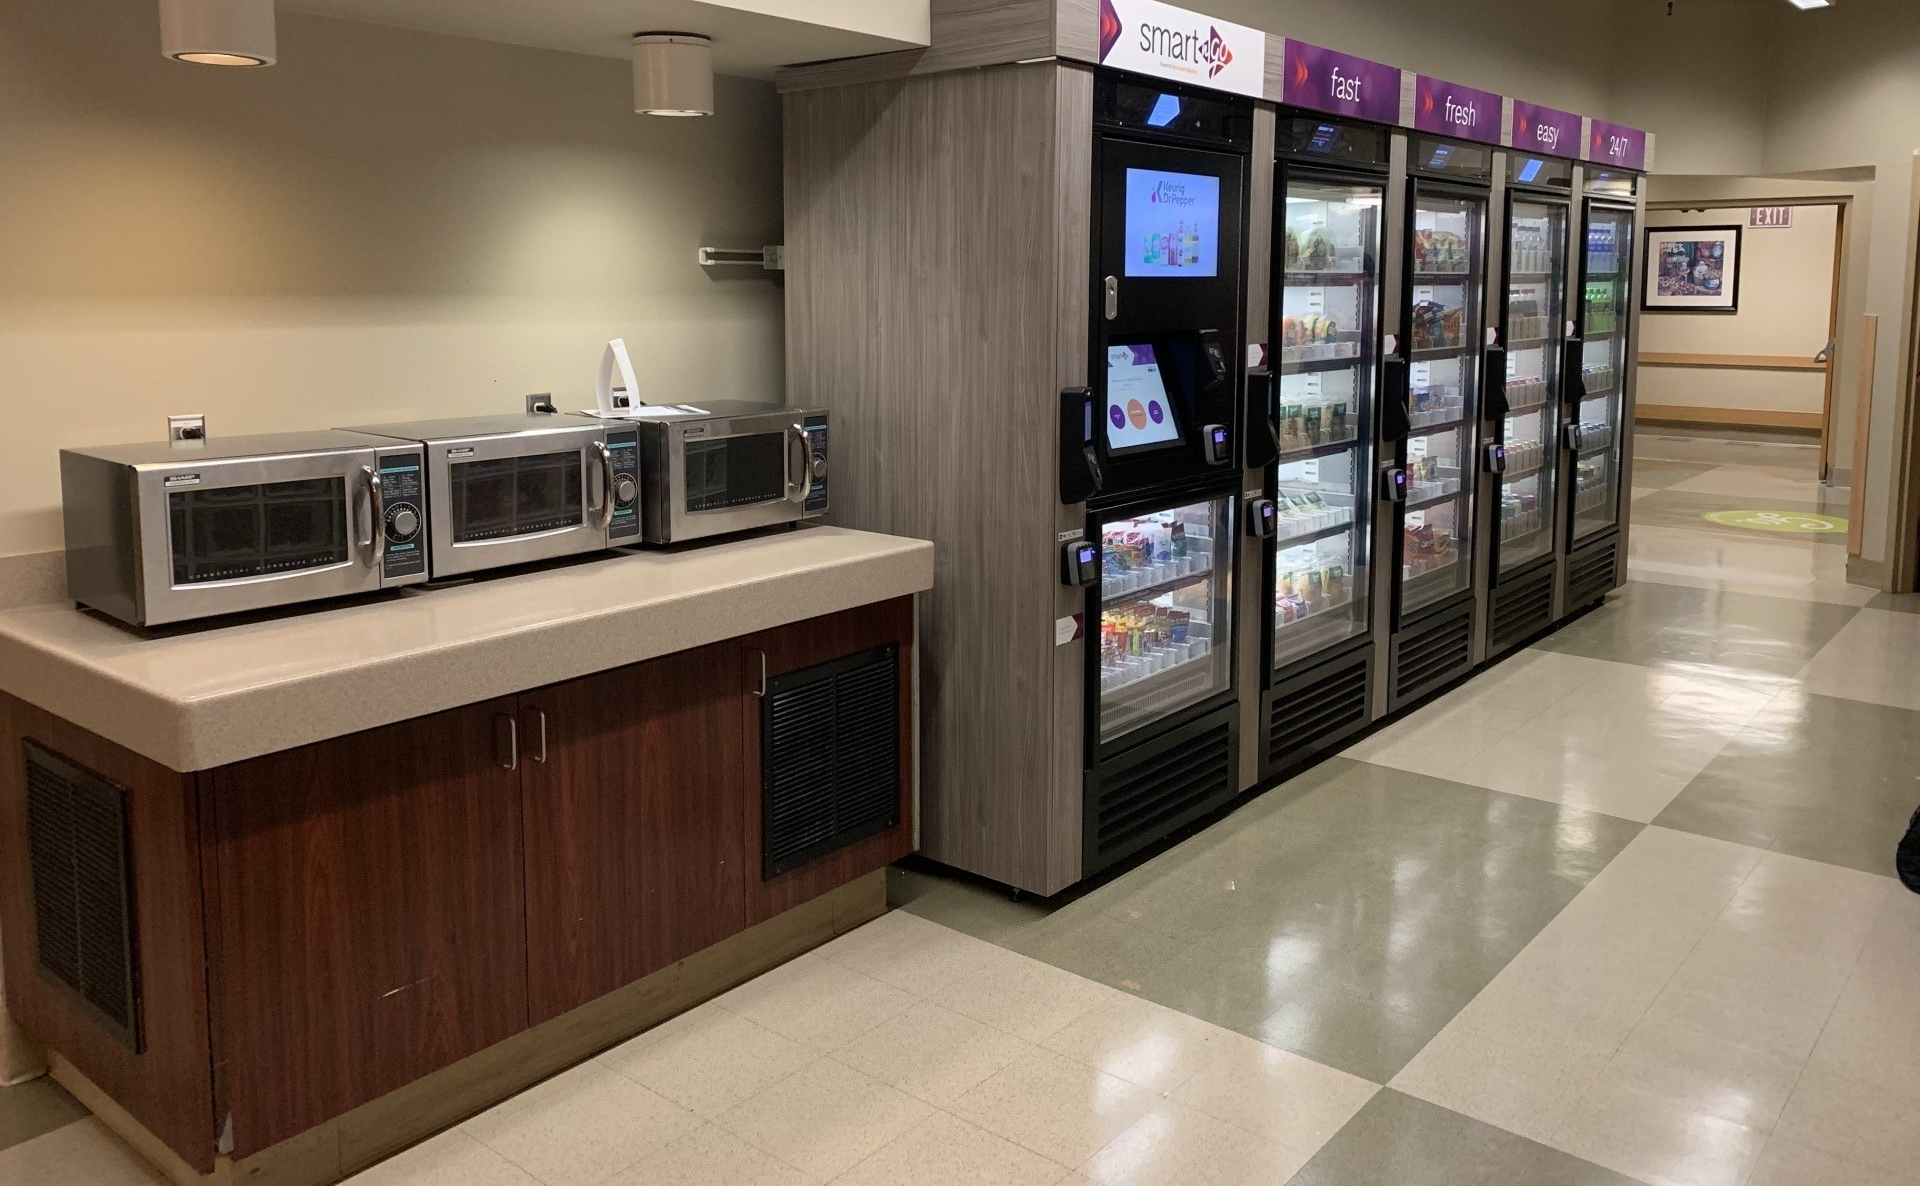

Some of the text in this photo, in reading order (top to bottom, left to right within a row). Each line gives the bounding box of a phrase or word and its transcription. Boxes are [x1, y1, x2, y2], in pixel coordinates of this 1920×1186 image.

[1140, 23, 1199, 64] smart
[1331, 66, 1362, 102] fast
[1445, 95, 1476, 127] fresh
[1536, 124, 1560, 150] easy
[1609, 135, 1629, 159] 24/7
[1164, 181, 1186, 195] Keurig
[1755, 207, 1786, 225] EXIT
